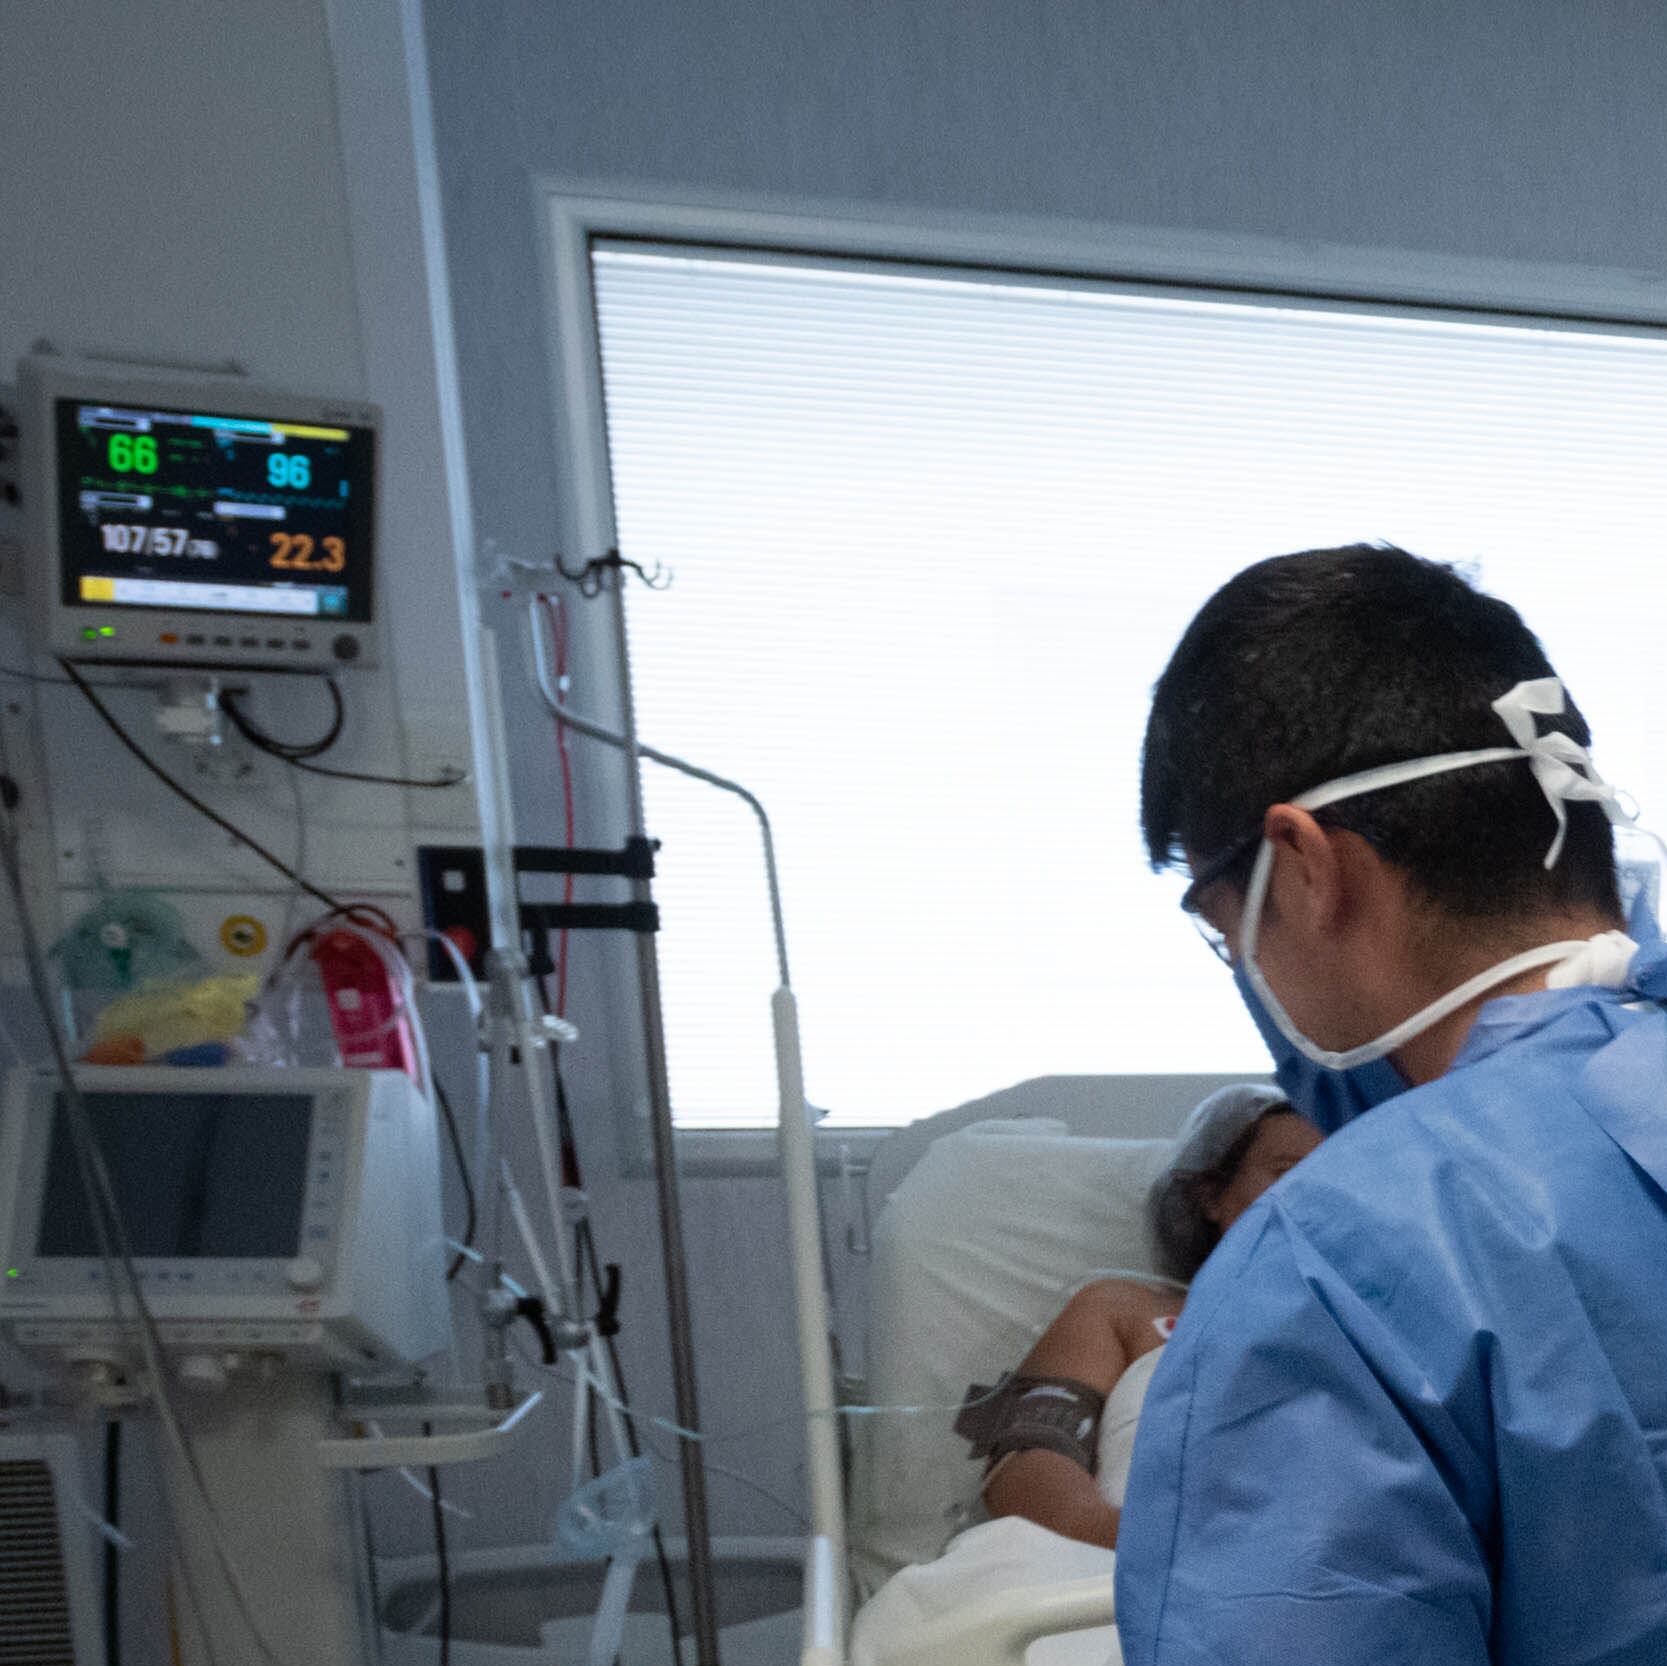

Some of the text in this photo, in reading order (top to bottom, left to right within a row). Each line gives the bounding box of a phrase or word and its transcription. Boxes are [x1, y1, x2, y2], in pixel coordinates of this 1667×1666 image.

[108, 433, 157, 475] 66
[267, 452, 311, 489] 96
[269, 531, 347, 572] 22.3
